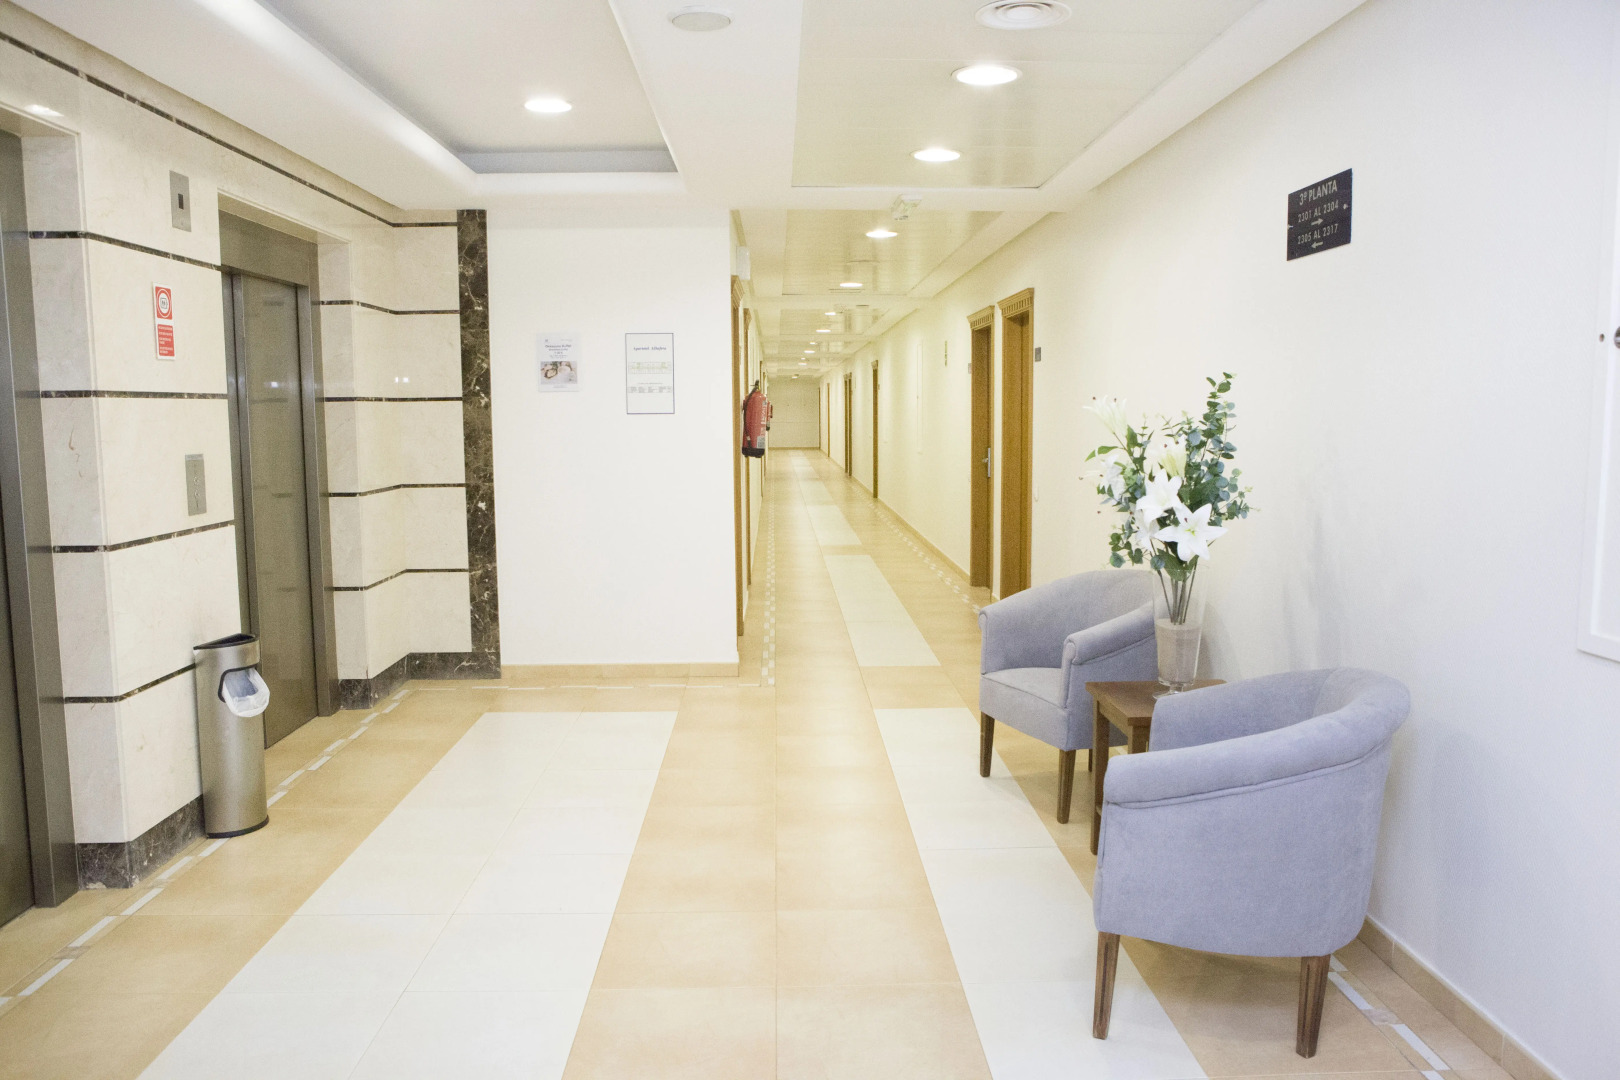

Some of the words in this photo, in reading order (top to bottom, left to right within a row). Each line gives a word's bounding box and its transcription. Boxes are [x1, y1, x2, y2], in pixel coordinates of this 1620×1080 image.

[1308, 180, 1338, 202] PLANTA
[1298, 210, 1312, 223] 2301
[1313, 207, 1321, 218] AL
[1323, 200, 1339, 214] 2304
[1297, 232, 1312, 245] 2305
[1313, 229, 1320, 240] AL
[1322, 223, 1339, 237] 2317
